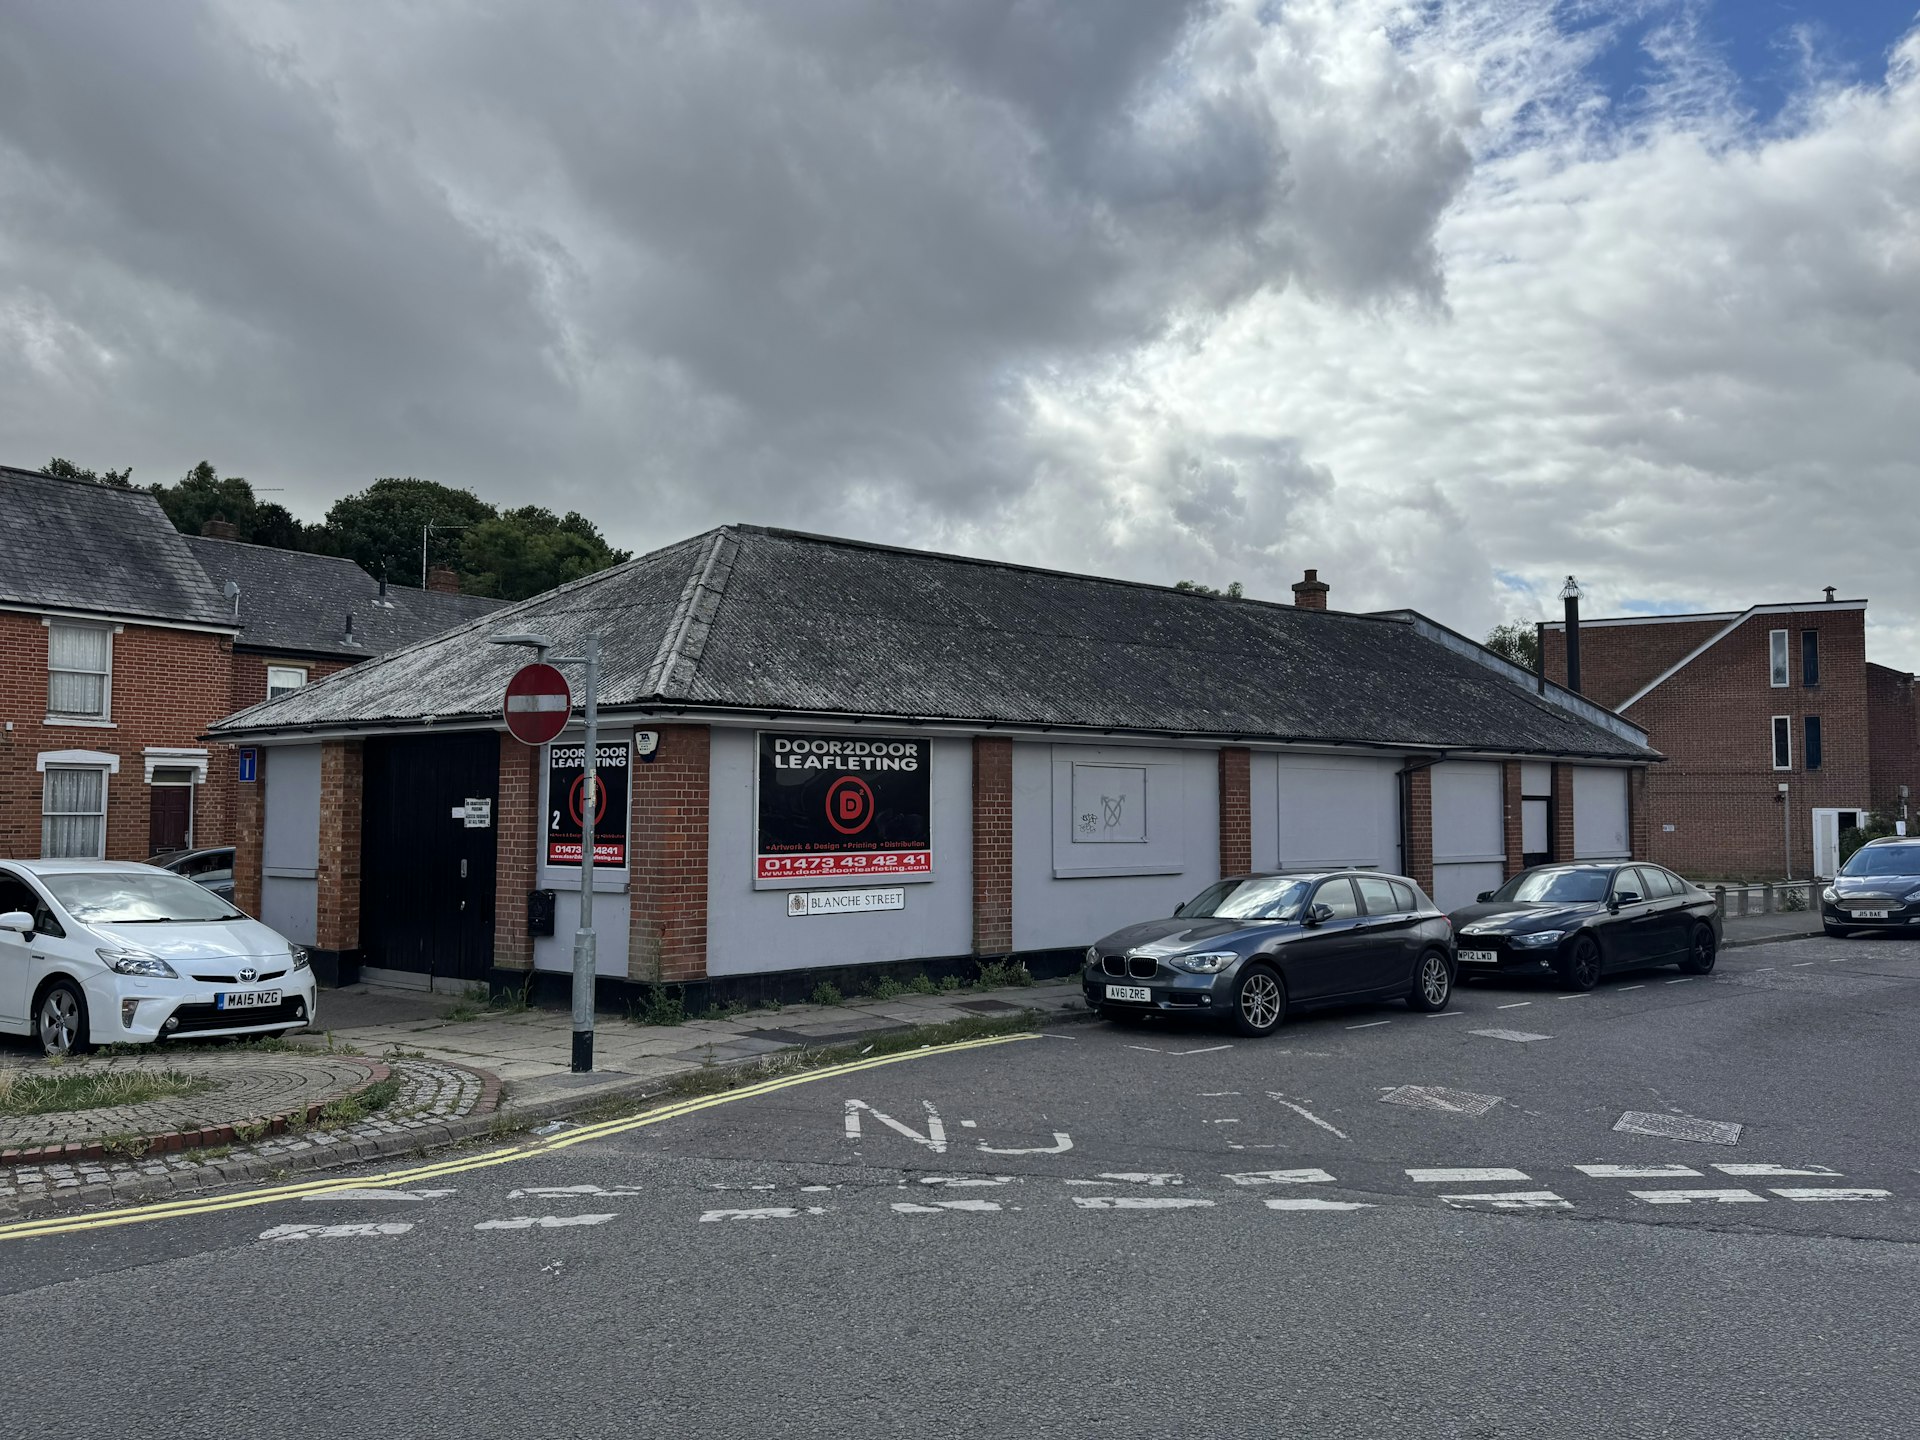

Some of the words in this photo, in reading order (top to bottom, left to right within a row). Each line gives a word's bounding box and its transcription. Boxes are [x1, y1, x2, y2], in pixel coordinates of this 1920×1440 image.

[775, 738, 918, 757] DOOR2DOOR
[775, 754, 918, 771] LEAFLETING
[552, 810, 561, 830] 2
[555, 845, 582, 853] 01473
[814, 842, 840, 850] Design
[848, 842, 877, 850] Printing
[885, 840, 925, 848] Distribution
[765, 859, 835, 870] 01473
[840, 856, 867, 867] 43
[872, 855, 898, 865] 42
[903, 854, 926, 865] 41
[761, 864, 929, 877] www.door2doorleafleting.com
[811, 896, 861, 908] BLANCHE
[865, 893, 903, 905] STREET
[228, 993, 255, 1006] MA15
[257, 991, 278, 1004] NZG
[1111, 986, 1128, 998] AV61
[1129, 988, 1146, 999] ZRE
